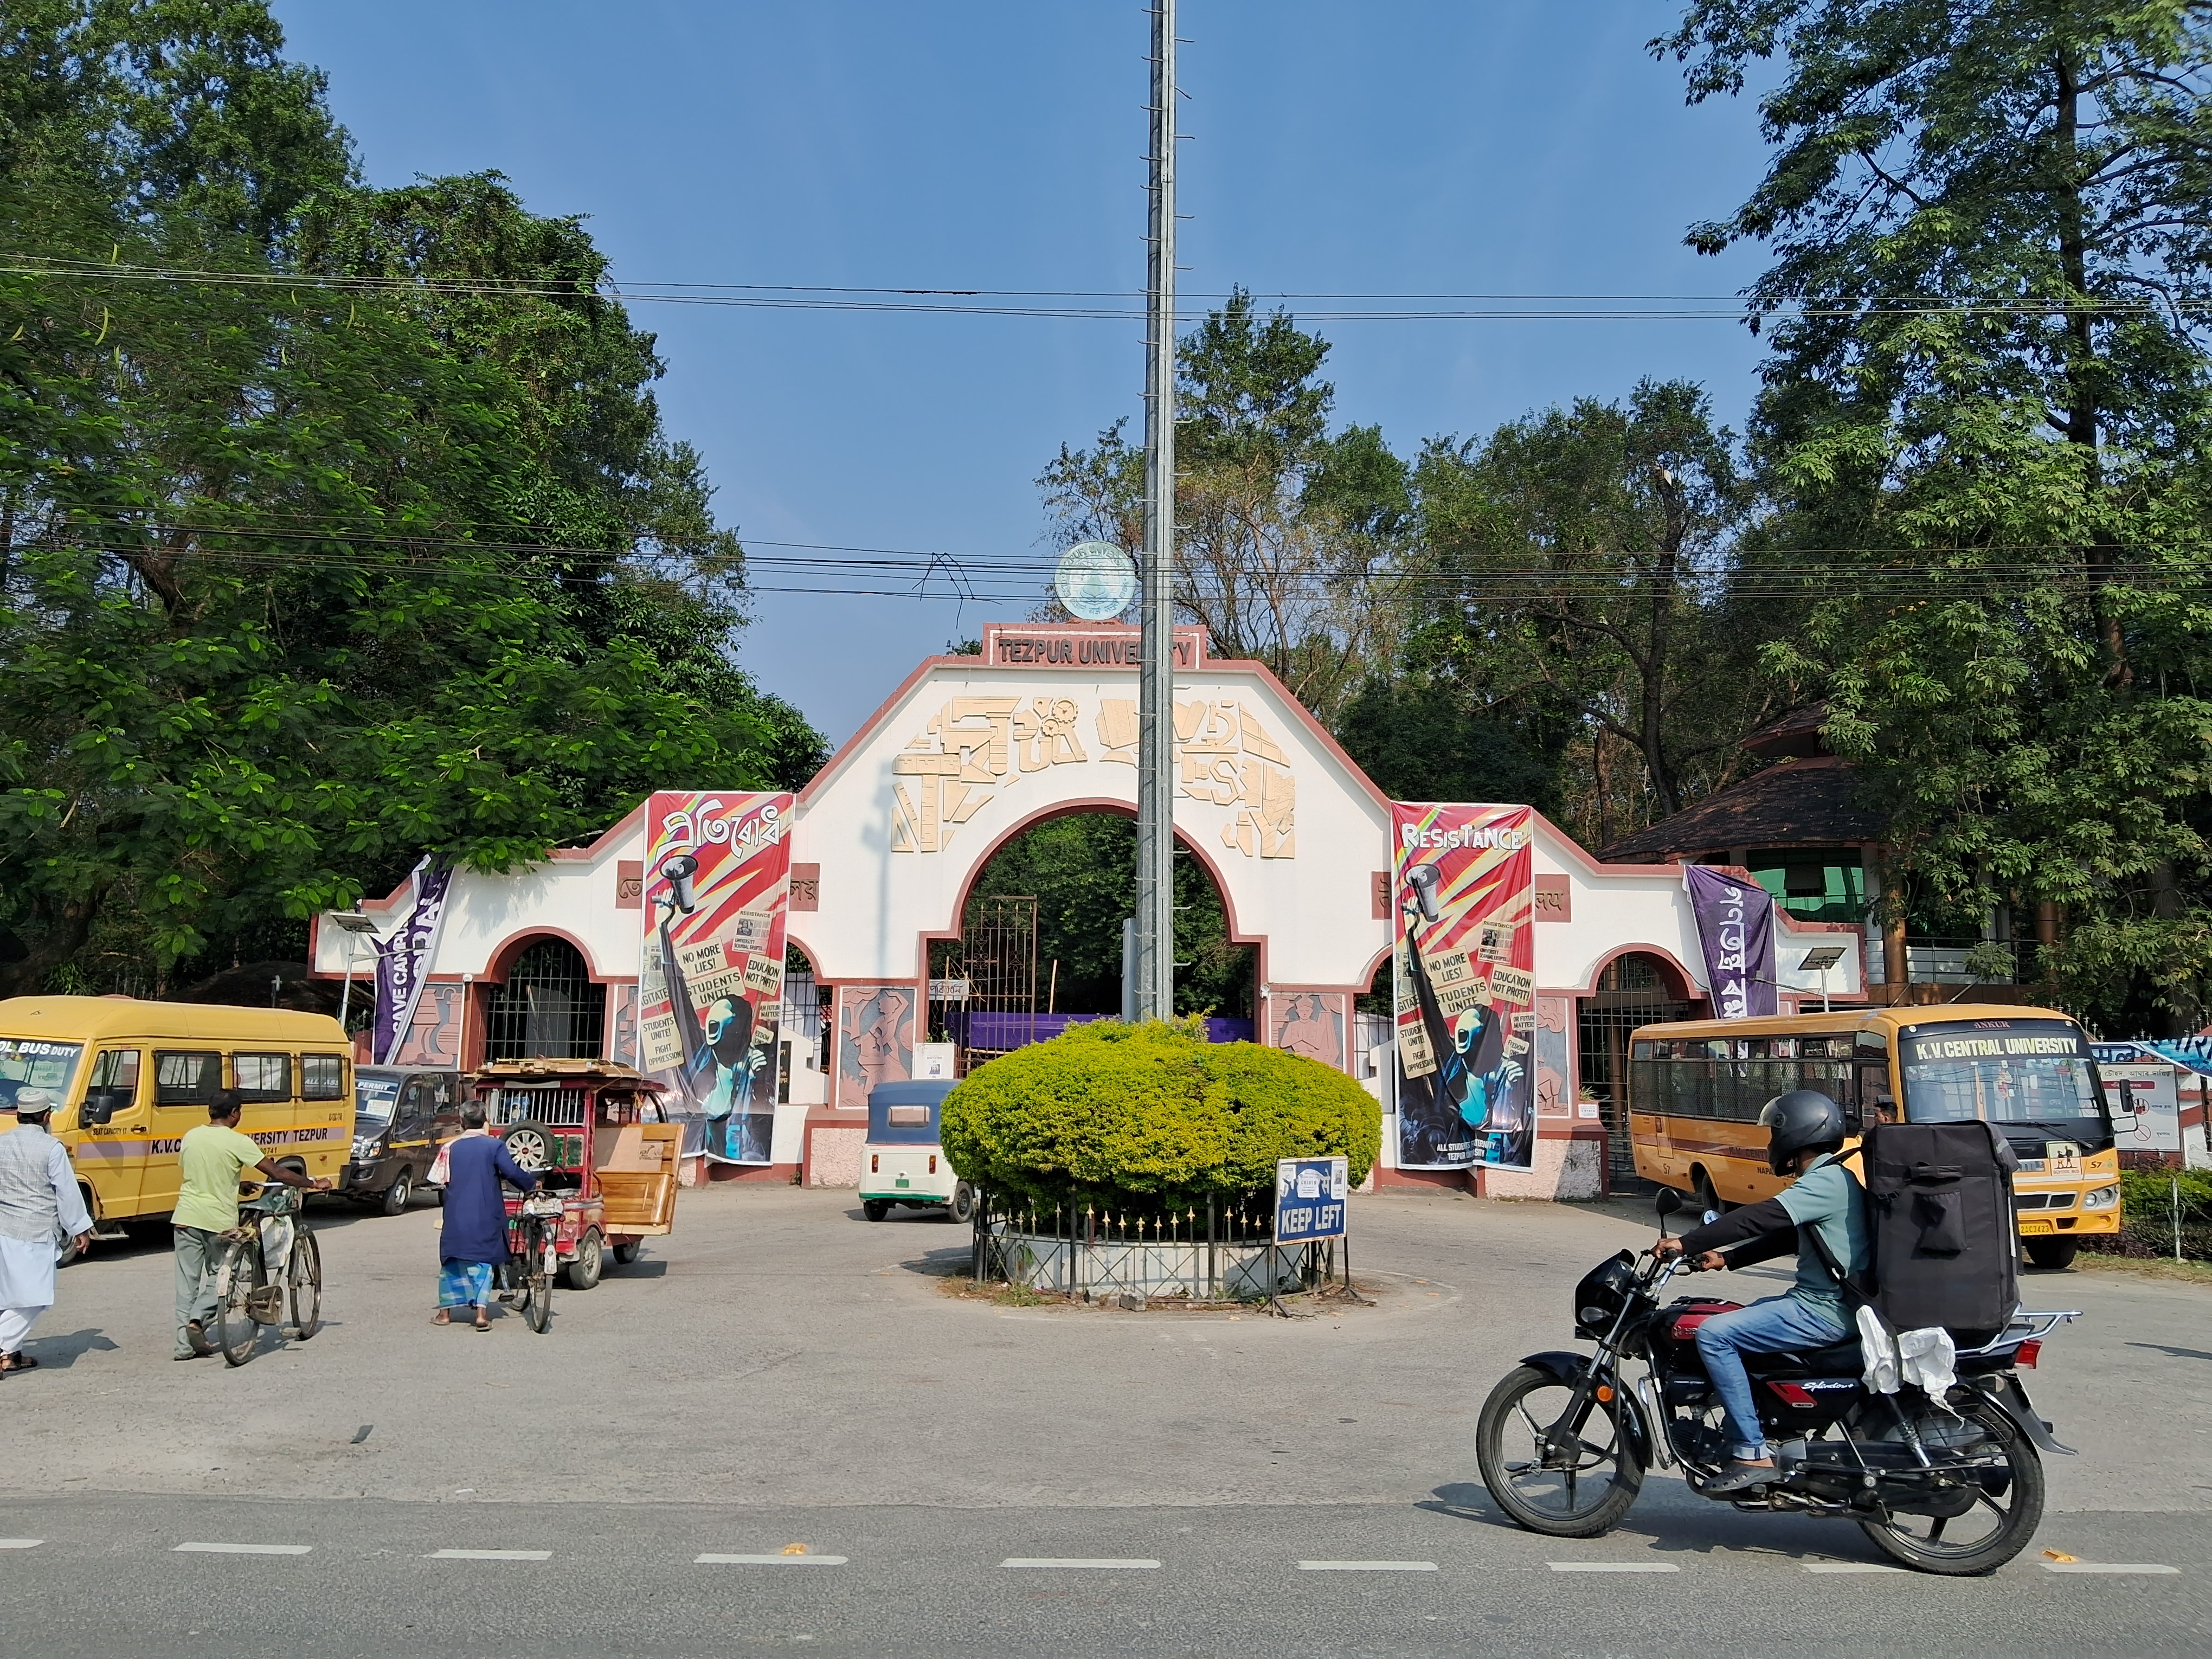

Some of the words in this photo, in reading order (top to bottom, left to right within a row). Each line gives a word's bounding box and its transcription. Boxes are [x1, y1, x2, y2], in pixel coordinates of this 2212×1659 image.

[998, 639, 1073, 664] TEZPUR
[1078, 640, 1191, 666] UNIVEY
[1401, 822, 1524, 850] RESISTANCE
[1483, 921, 1513, 929] RESISTANCE
[393, 920, 409, 985] CAMPU
[682, 953, 695, 964] NO
[697, 943, 721, 959] MORE
[694, 957, 717, 974] LIES!
[1428, 959, 1441, 972] NO
[1443, 952, 1467, 968] MORE
[745, 971, 761, 983] NOT
[1441, 966, 1463, 982] LIES!
[1493, 969, 1532, 989] EDUCATION
[686, 972, 741, 997] STUDENTS
[1490, 981, 1506, 994] NOT
[1436, 982, 1487, 1005] STUDENTS
[643, 1016, 674, 1032] STUDENTS
[1973, 1021, 2011, 1029] ANKUR
[650, 1027, 672, 1040] UNITE!
[18, 1041, 52, 1055] BUS
[50, 1046, 78, 1058] DUTY
[655, 1043, 672, 1055] FIGHT
[2005, 1038, 2078, 1054] UNIVERSITY
[648, 1050, 683, 1066] OPPRESSION!
[1412, 1050, 1426, 1061] FIGHT
[357, 1081, 390, 1091] PERMIT
[293, 1128, 328, 1142] TEZPUR
[1437, 1143, 1448, 1152] ALL
[1447, 1152, 1466, 1161] TEZPUR
[1663, 1163, 1670, 1175] S7
[2091, 1161, 2102, 1169] S7
[1281, 1207, 1313, 1234] KEEP
[1315, 1204, 1341, 1230] LEFT
